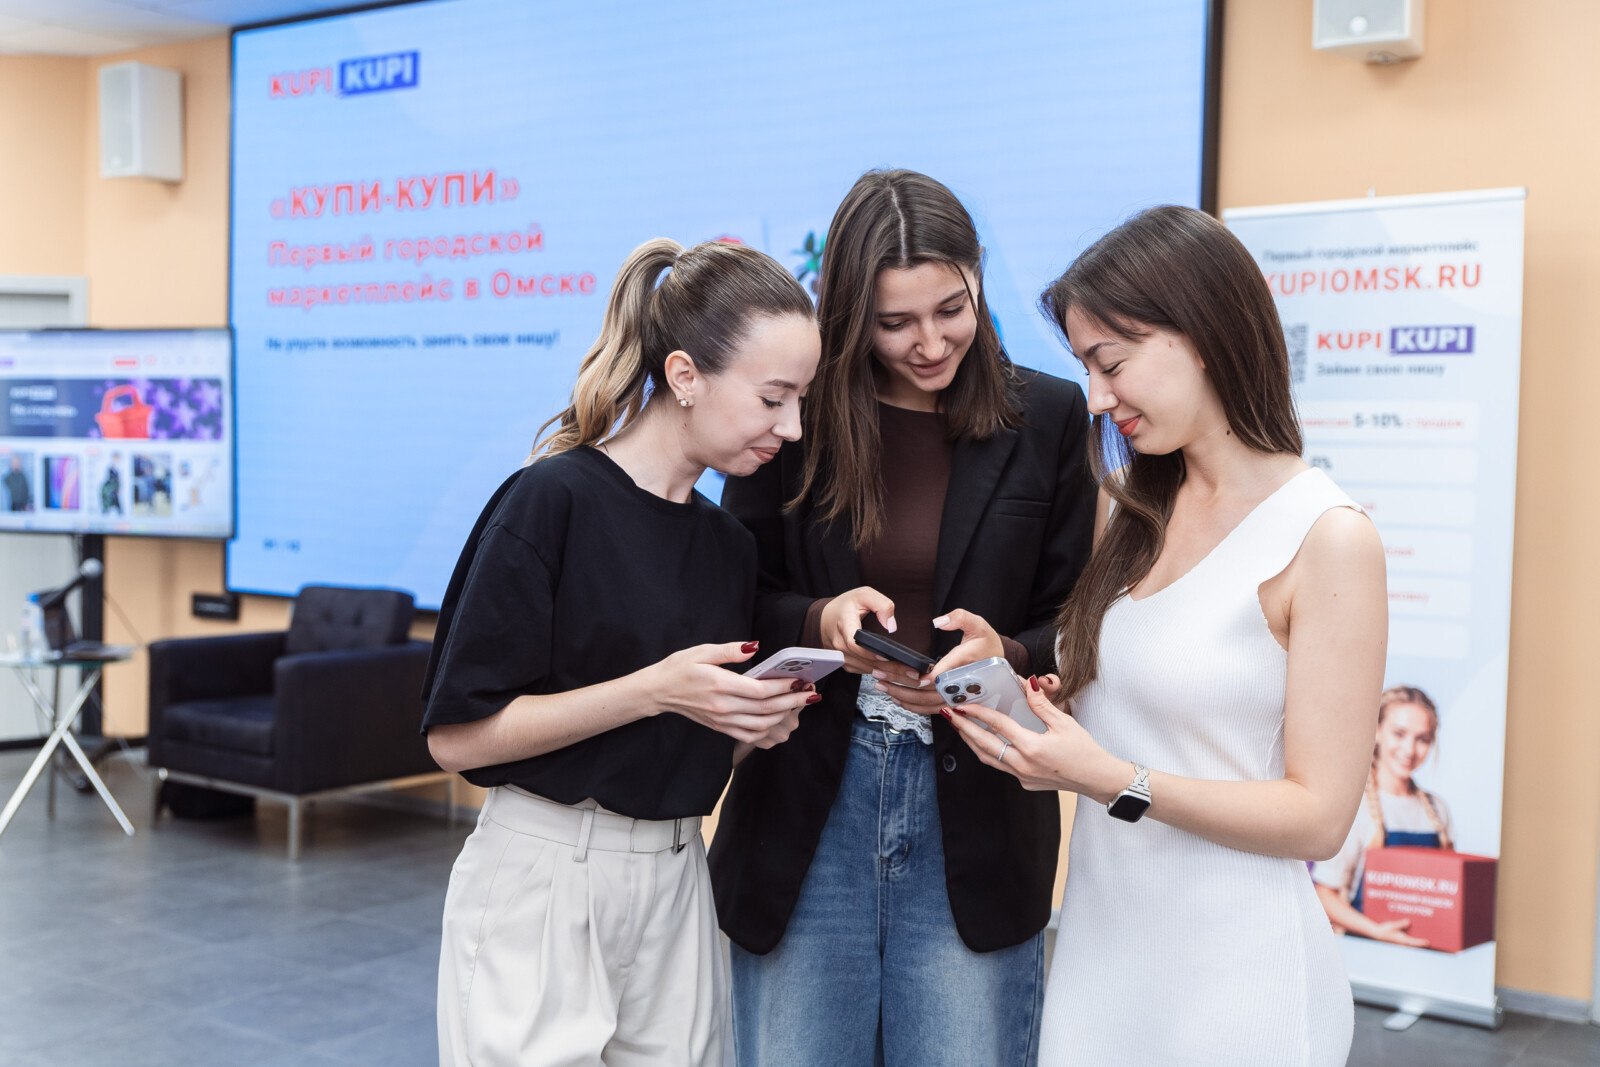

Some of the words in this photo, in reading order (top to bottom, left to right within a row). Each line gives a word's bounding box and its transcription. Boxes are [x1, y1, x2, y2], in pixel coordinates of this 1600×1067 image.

[271, 67, 333, 98] KUPI
[344, 54, 414, 91] KUPI
[270, 170, 520, 218] «КУПИ-КУПИ»
[269, 234, 374, 270] Первый
[385, 222, 544, 265] городской
[268, 273, 453, 313] маркетплейс
[464, 278, 479, 299] в
[491, 270, 597, 298] Омске
[1316, 332, 1382, 351] KUPI
[1396, 327, 1468, 352] KUPI
